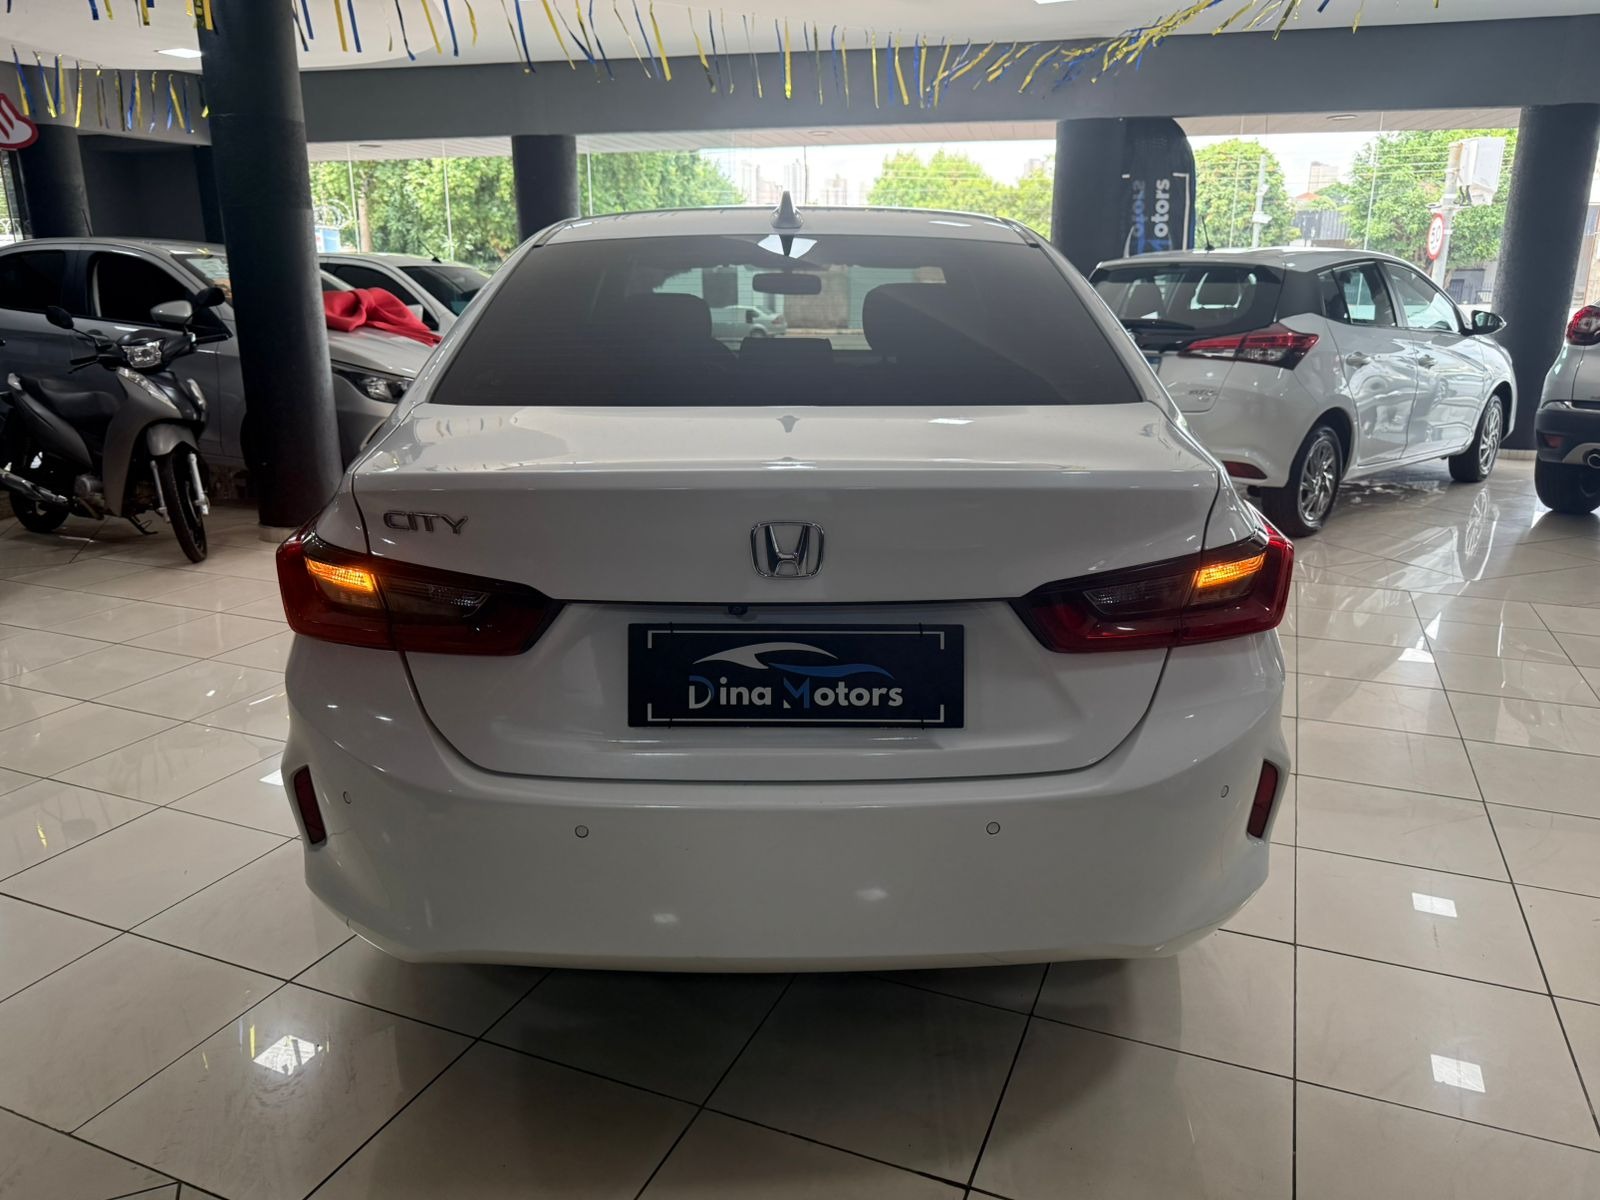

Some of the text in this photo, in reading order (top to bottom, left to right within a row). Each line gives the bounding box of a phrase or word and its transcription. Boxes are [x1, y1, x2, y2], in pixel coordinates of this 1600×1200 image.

[382, 509, 469, 535] CITY
[688, 675, 904, 709] Dina Motors
